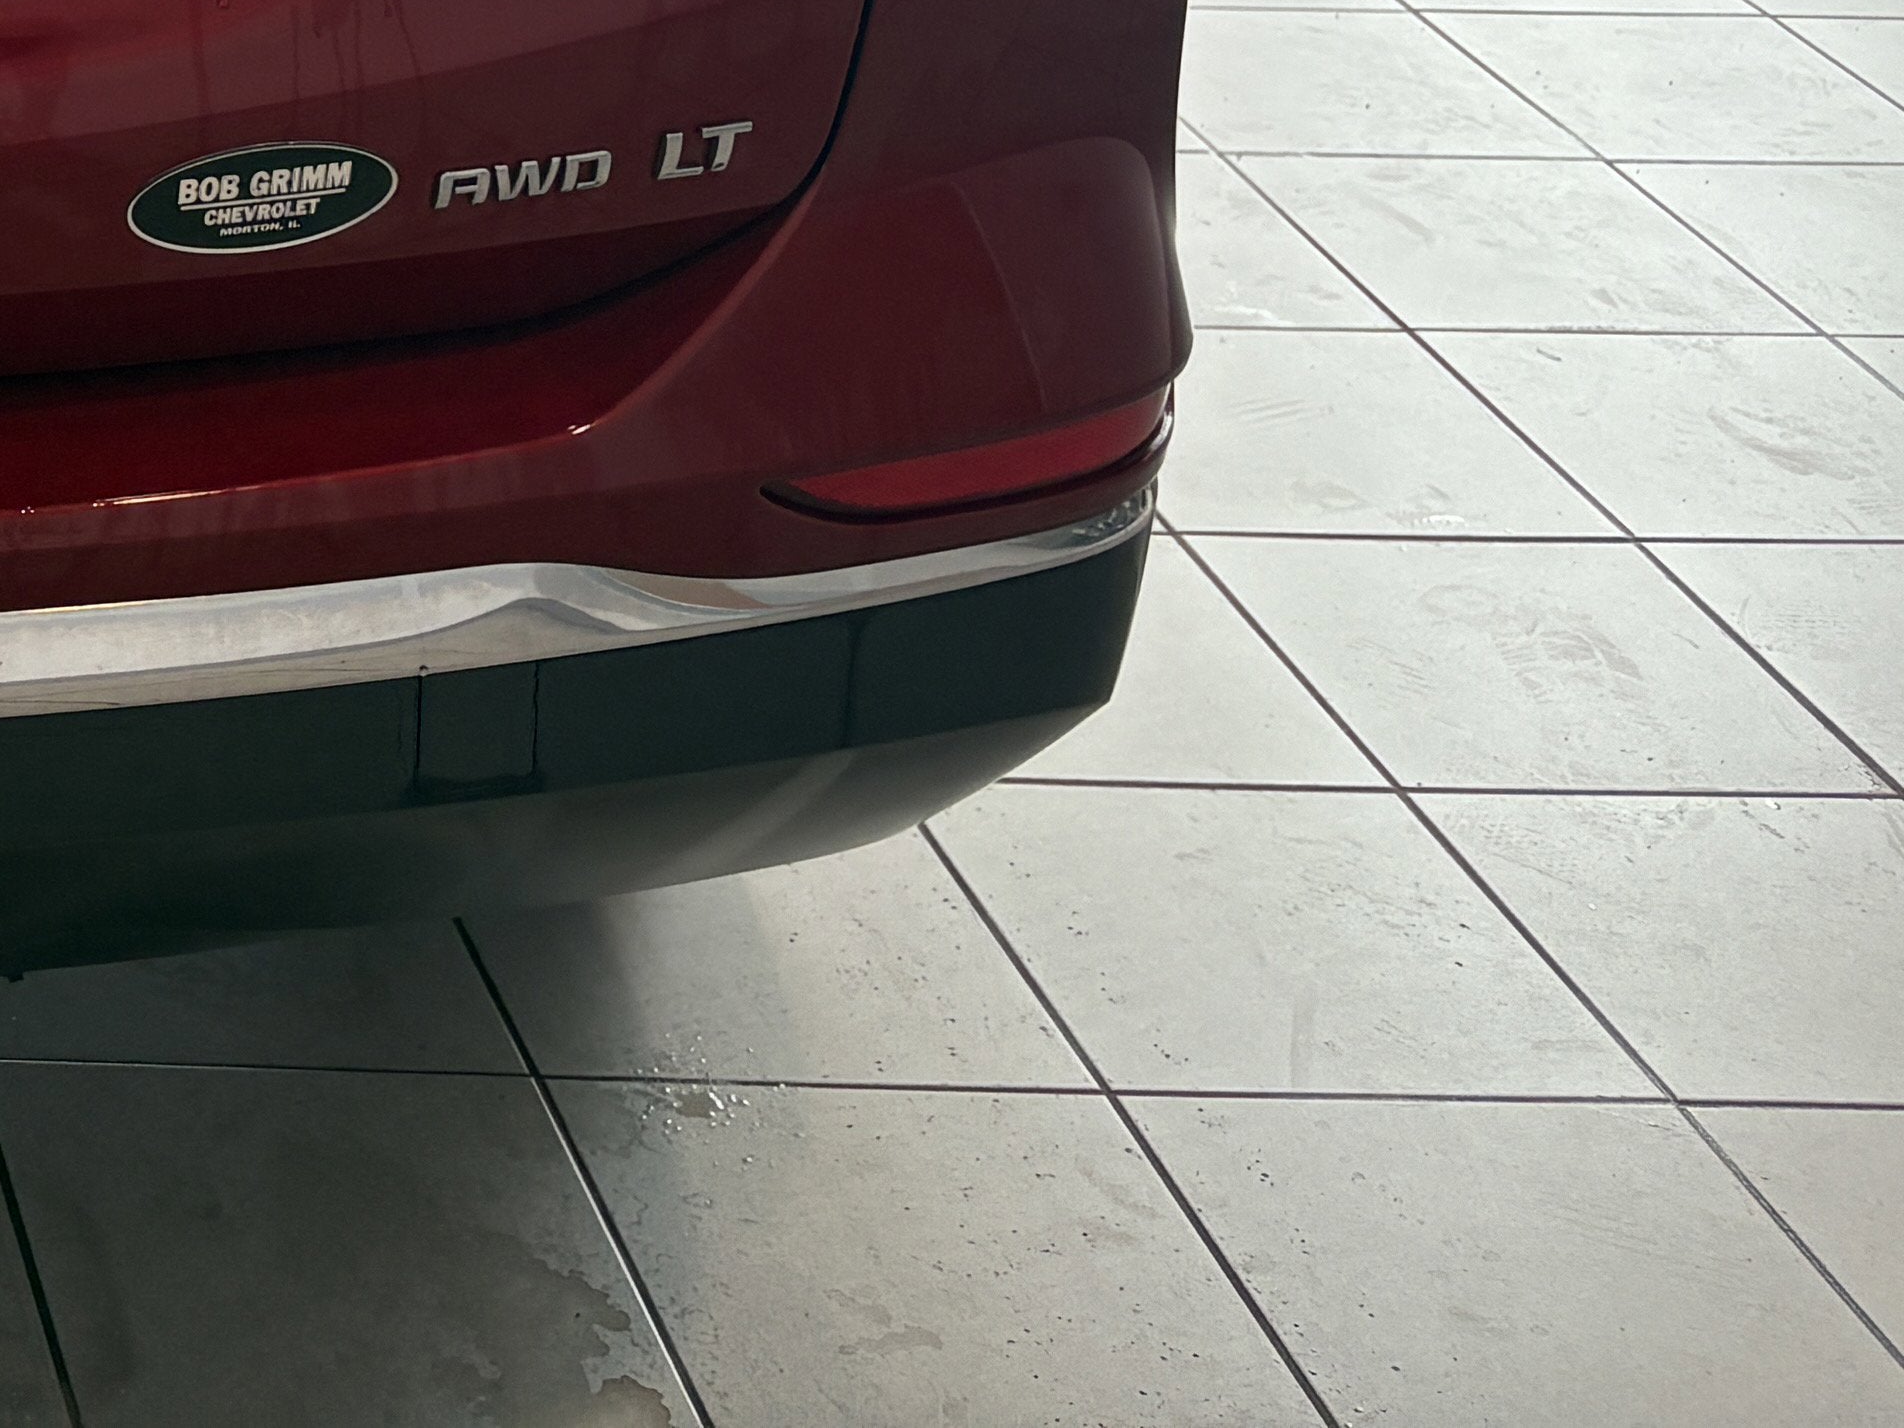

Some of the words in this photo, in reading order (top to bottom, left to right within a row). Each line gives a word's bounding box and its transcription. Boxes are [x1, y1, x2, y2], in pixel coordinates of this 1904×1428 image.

[176, 173, 239, 206] BOB
[248, 159, 353, 199] GRIMM
[434, 150, 614, 208] AWD
[658, 121, 753, 180] LT
[204, 197, 320, 226] CHEVROLET
